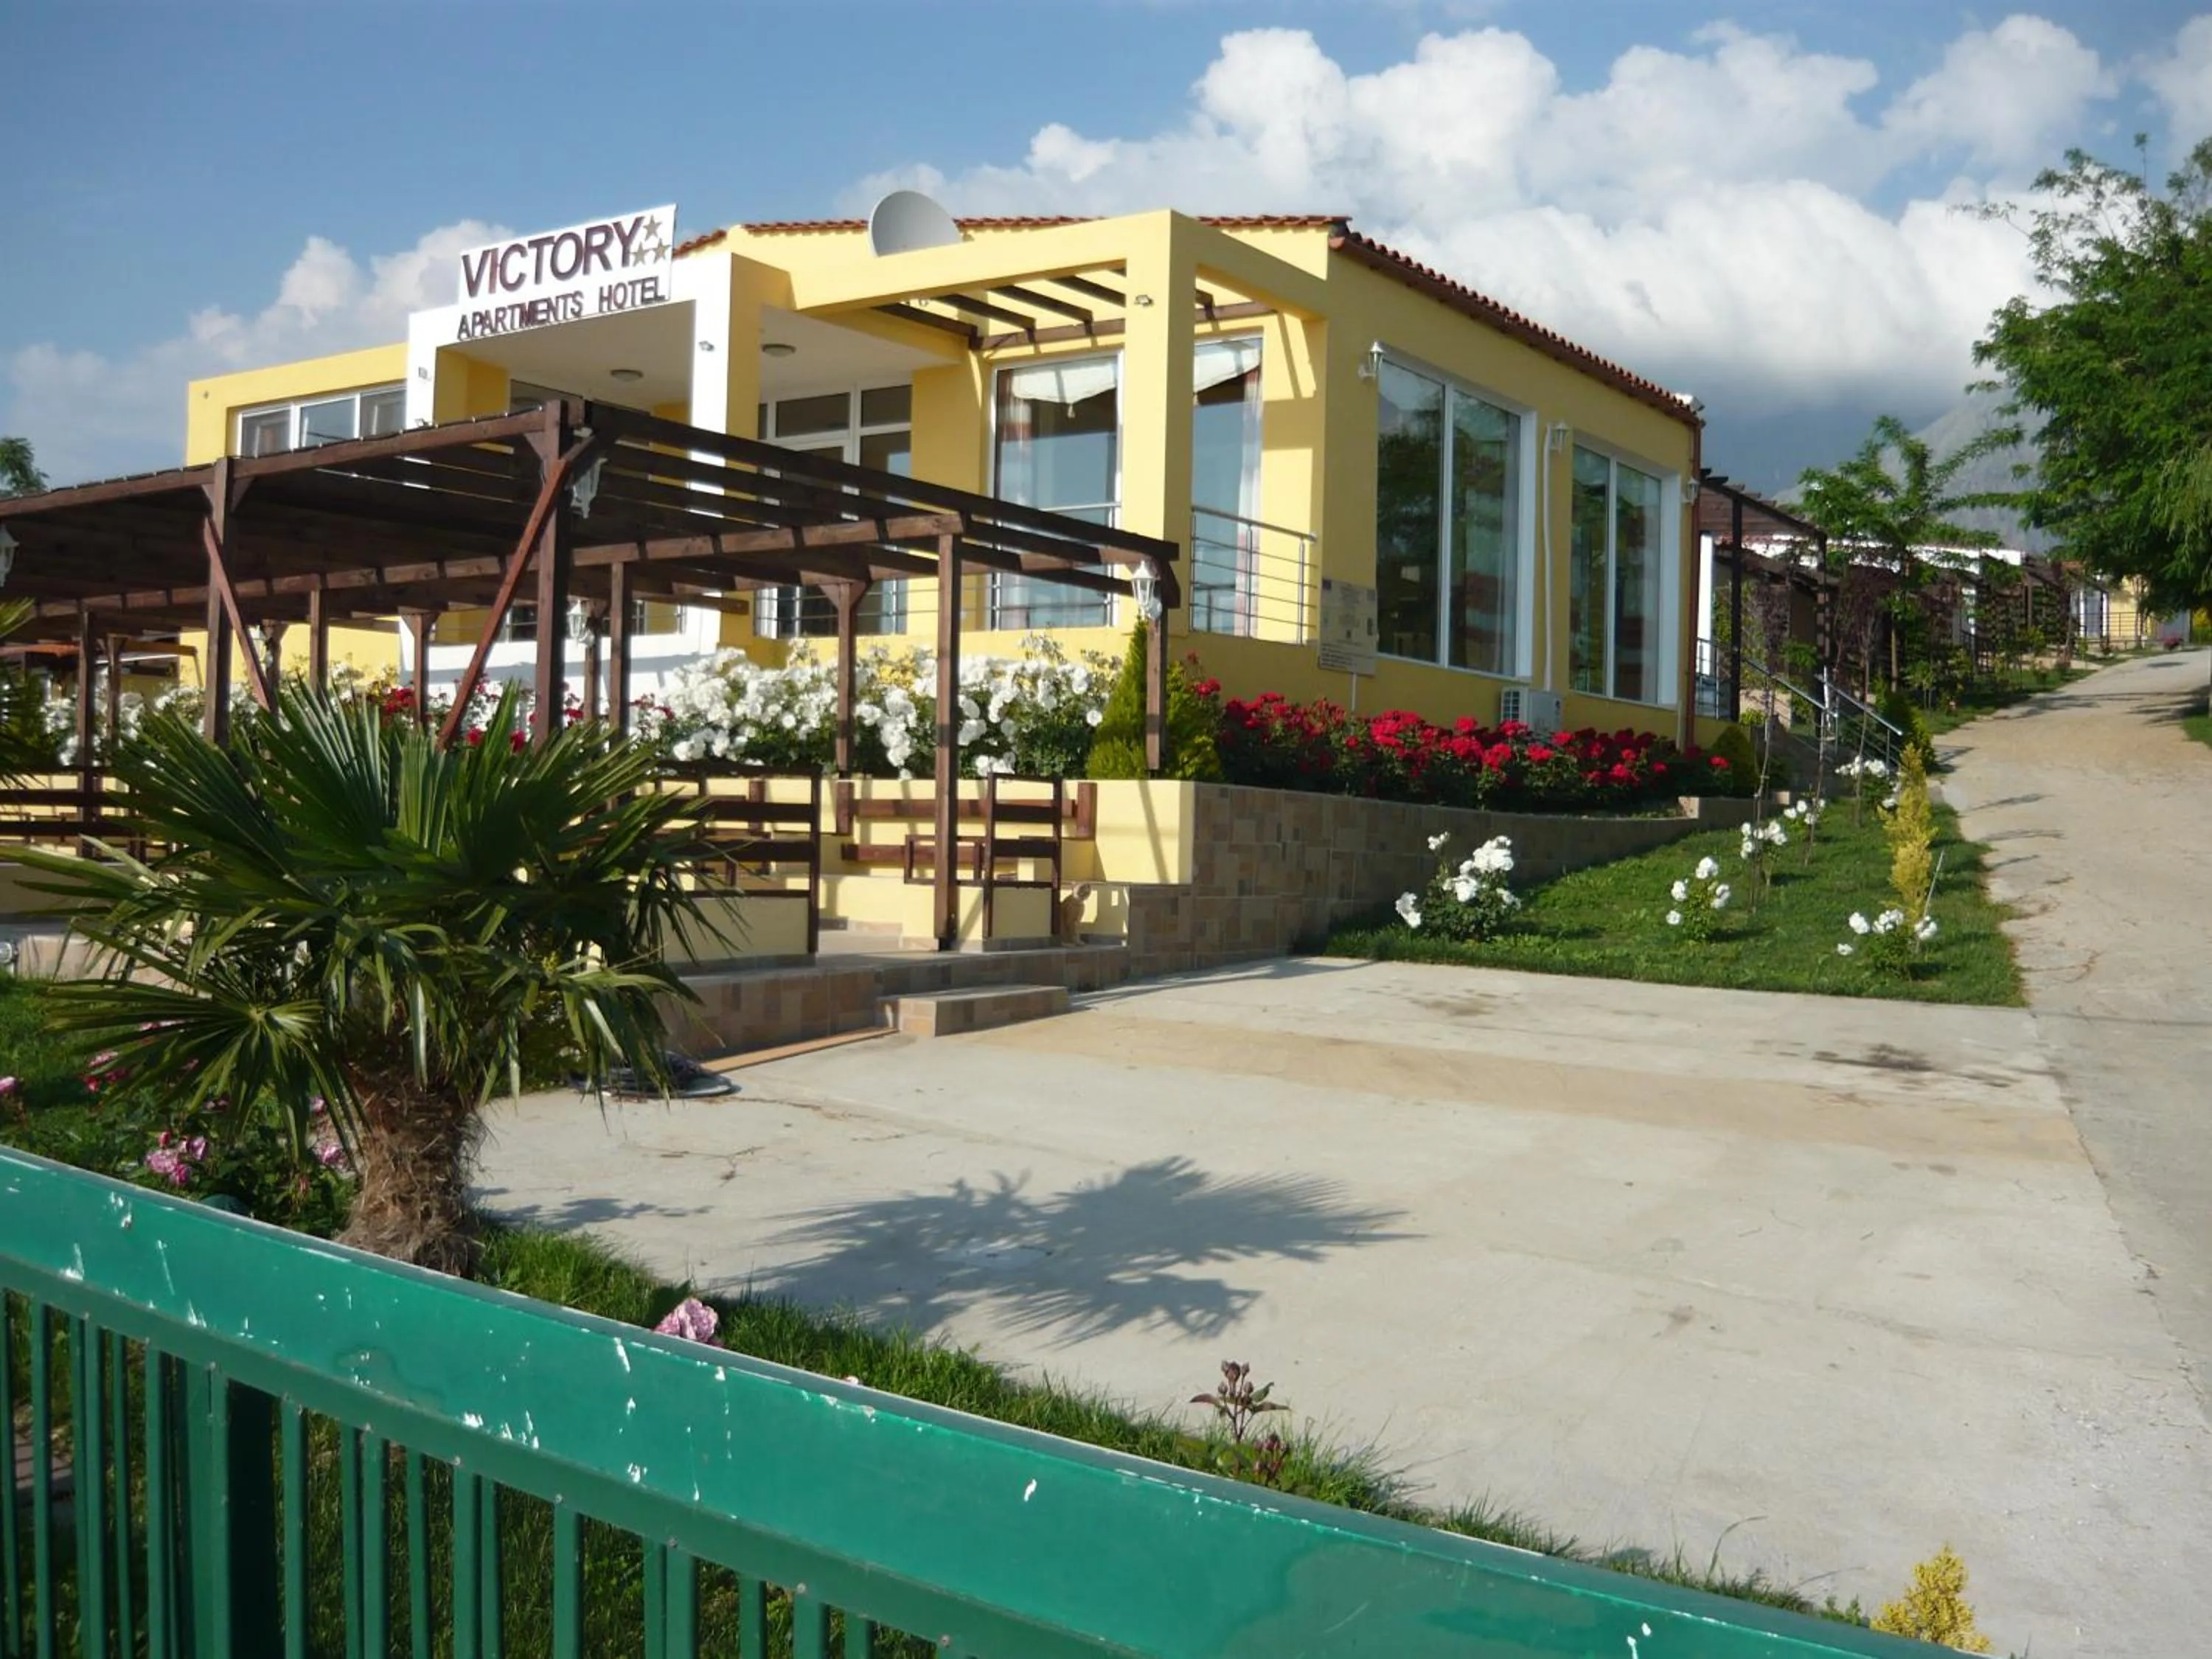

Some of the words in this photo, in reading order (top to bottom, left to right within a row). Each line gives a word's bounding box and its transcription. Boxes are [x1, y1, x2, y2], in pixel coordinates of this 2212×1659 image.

[462, 216, 645, 298] VICTORY
[457, 291, 584, 341] APARTMENTS
[598, 276, 666, 313] HOTEL
